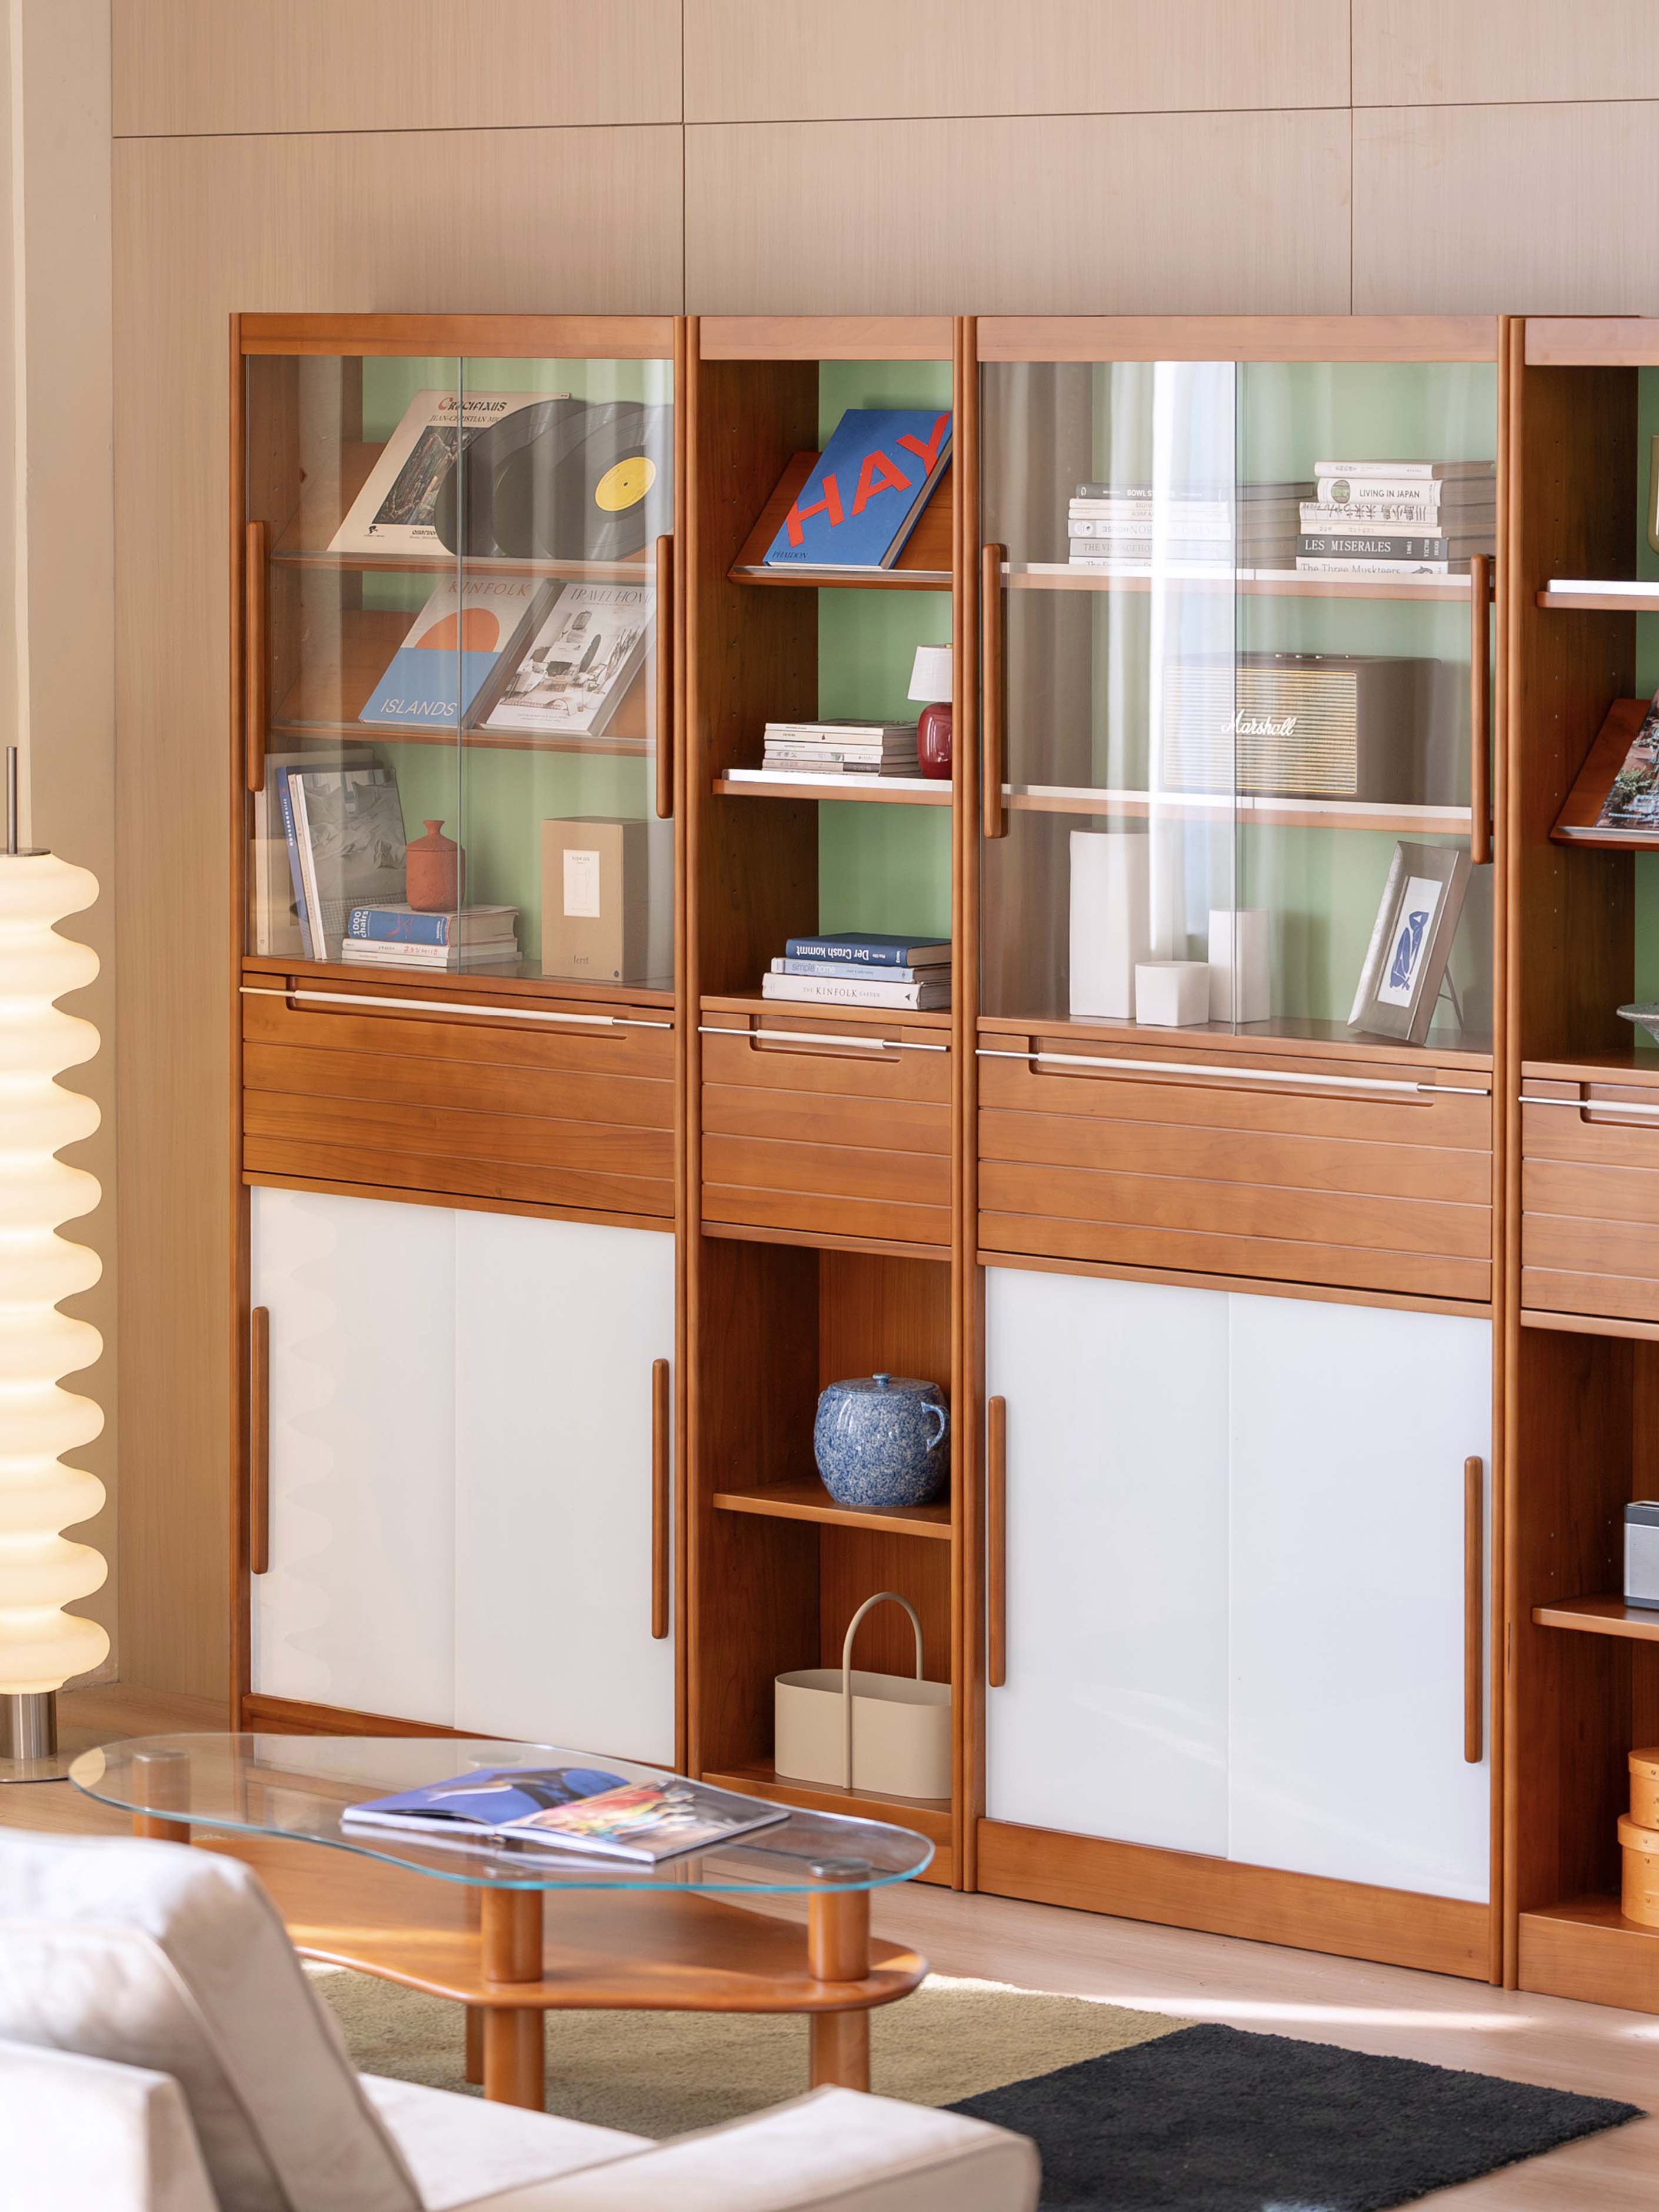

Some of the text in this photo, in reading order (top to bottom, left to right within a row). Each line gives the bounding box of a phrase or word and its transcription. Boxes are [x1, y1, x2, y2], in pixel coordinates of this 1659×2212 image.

[785, 411, 951, 548] HAY
[1359, 489, 1385, 498] LIVING
[1083, 543, 1100, 552] THE
[1304, 539, 1391, 552] LES MISERALES
[448, 581, 531, 596] KINFOLK
[380, 698, 458, 717] ISLANDS
[1220, 708, 1297, 737] Marshall
[352, 911, 361, 935] 1000
[359, 911, 369, 938] chairs
[828, 948, 852, 960] Crash
[854, 949, 870, 961] Der
[815, 987, 858, 998] KINFOLK
